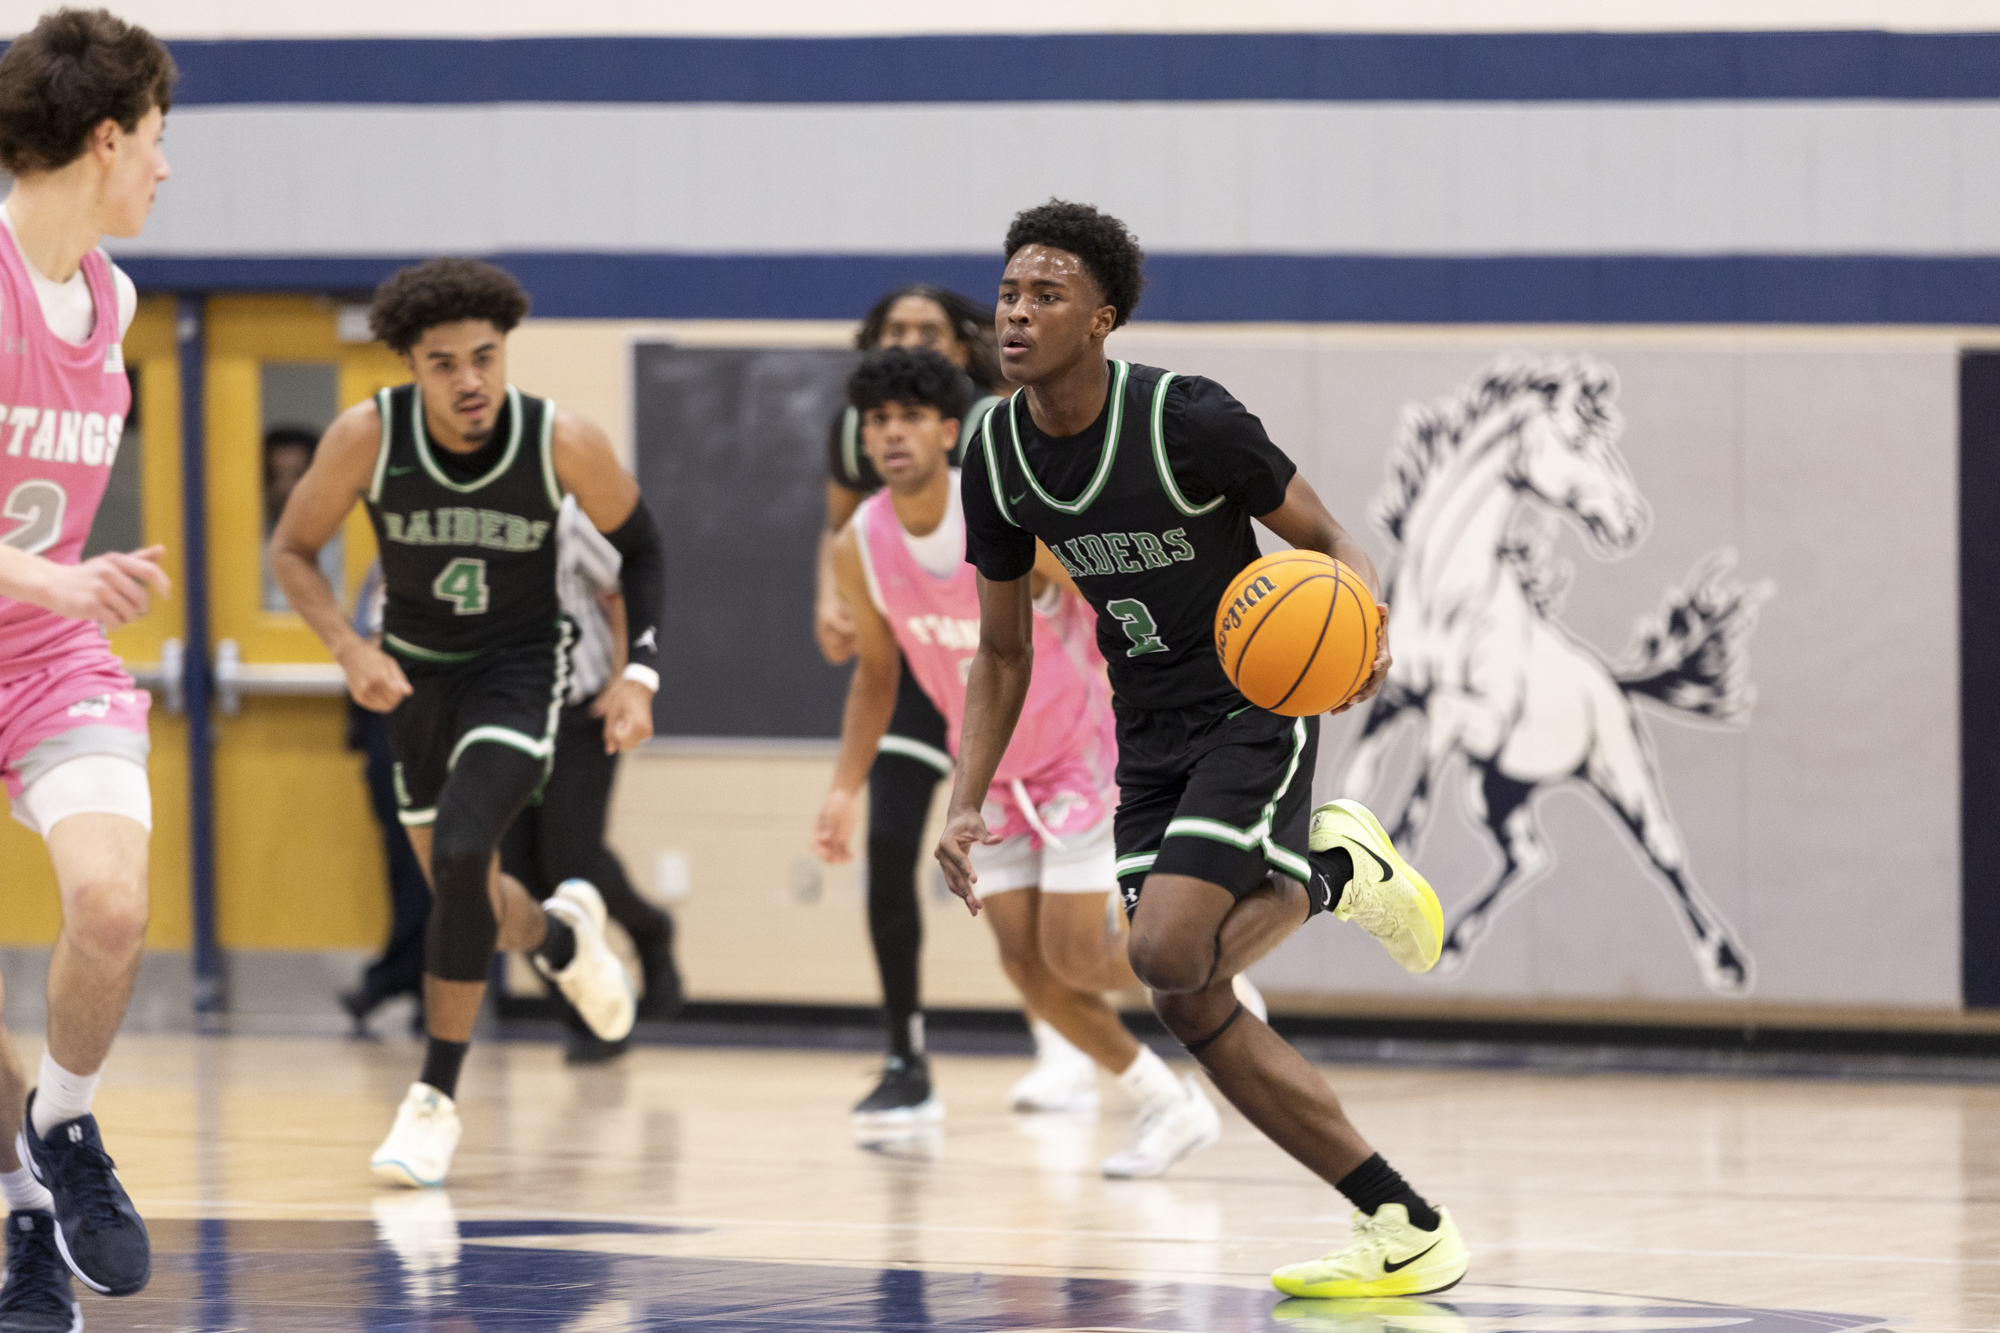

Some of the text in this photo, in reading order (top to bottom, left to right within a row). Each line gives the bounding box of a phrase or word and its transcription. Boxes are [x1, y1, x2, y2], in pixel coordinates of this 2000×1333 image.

[1, 478, 67, 554] 2
[432, 557, 489, 616] 4
[1106, 598, 1170, 657] 2
